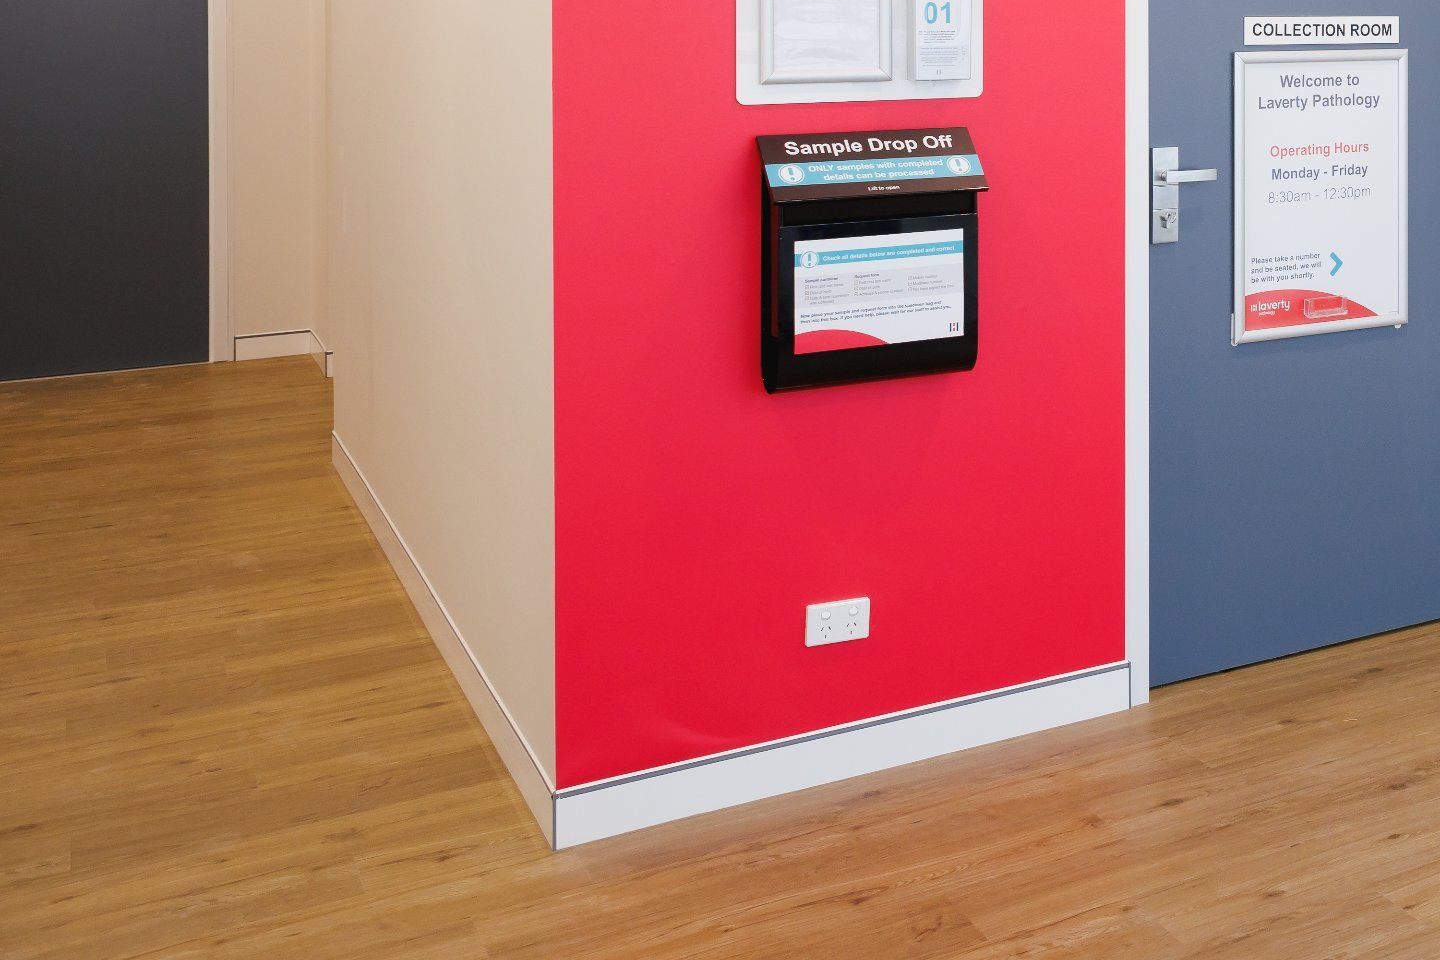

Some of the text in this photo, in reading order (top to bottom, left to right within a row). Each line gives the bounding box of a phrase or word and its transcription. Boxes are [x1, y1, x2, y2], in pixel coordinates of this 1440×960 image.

[924, 1, 950, 24] 01
[1252, 23, 1392, 37] COLLECTION ROOM
[1280, 74, 1360, 88] Welcome to
[1258, 93, 1380, 111] Laverty Pathology
[784, 134, 953, 157] Sample Drop Off
[1270, 142, 1369, 159] Operating Hours
[808, 159, 944, 173] ONLY samples with completed
[1271, 167, 1320, 181] Monday
[1332, 164, 1368, 177] Friday
[823, 168, 935, 181] details can be processed
[1268, 191, 1311, 204] 8:30am
[1323, 186, 1371, 200] 12:30pm
[1251, 257, 1273, 265] Please
[1251, 266, 1263, 274] and
[1276, 274, 1289, 283] you
[1258, 299, 1290, 312] laverty
